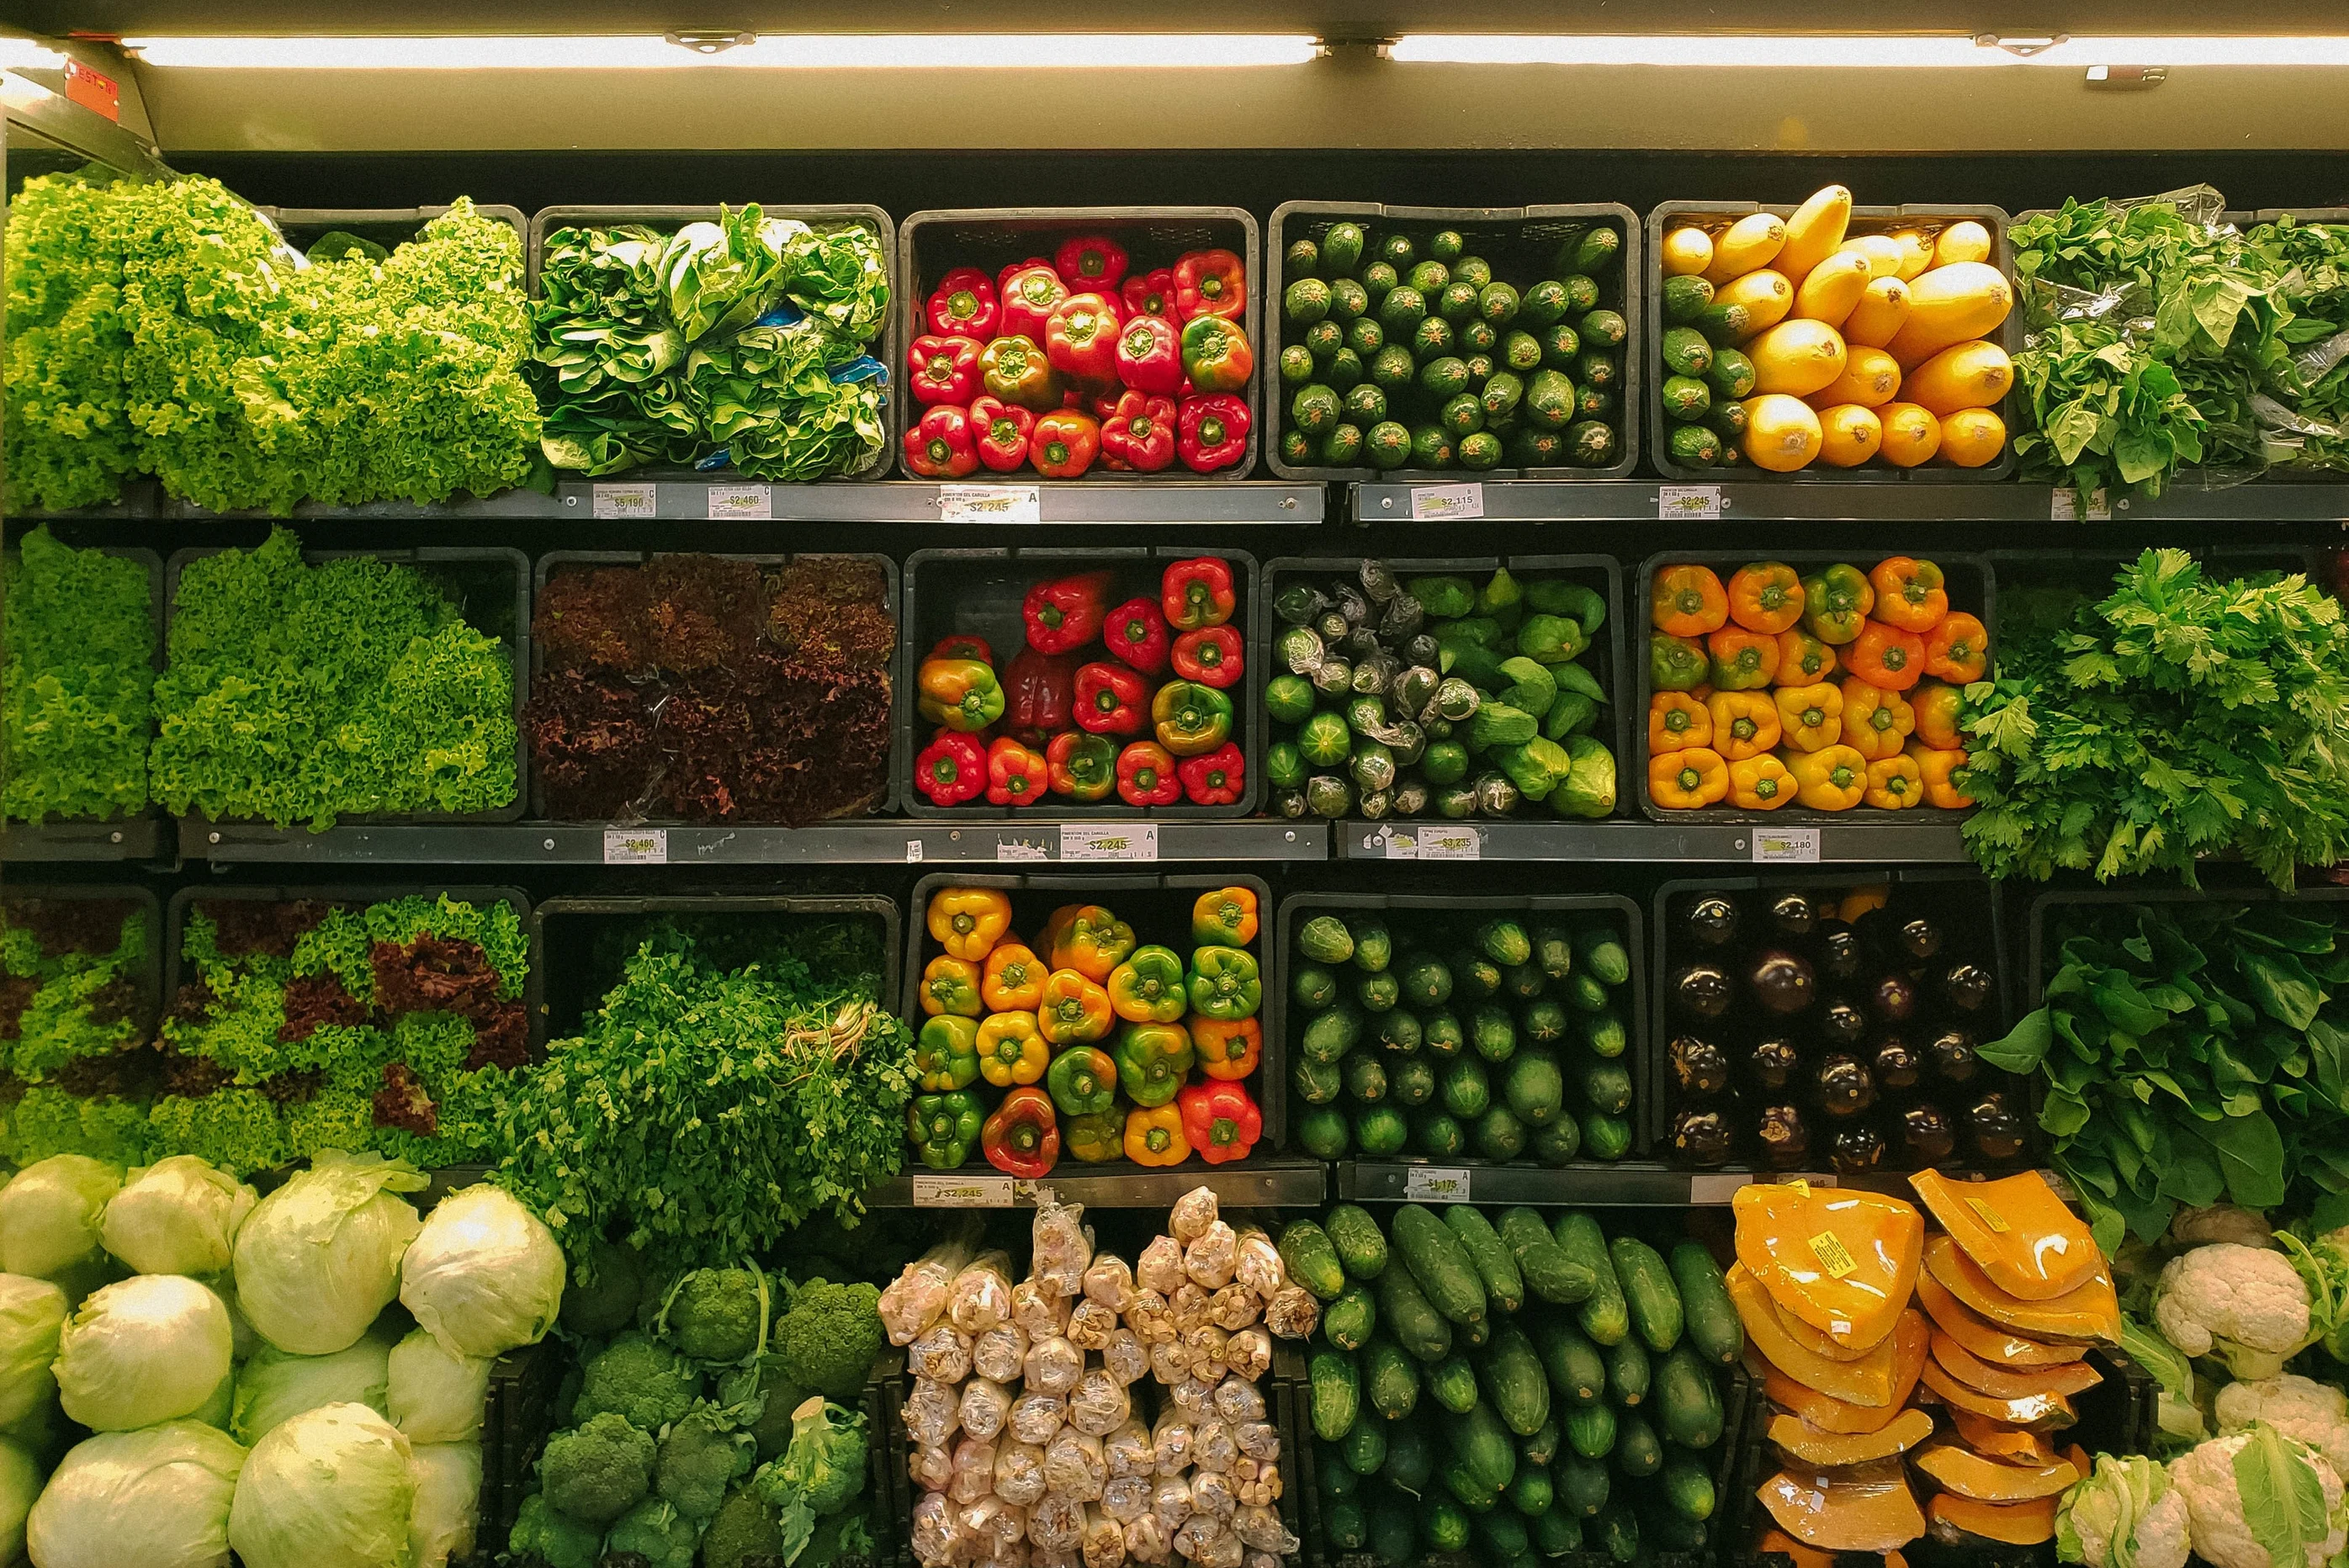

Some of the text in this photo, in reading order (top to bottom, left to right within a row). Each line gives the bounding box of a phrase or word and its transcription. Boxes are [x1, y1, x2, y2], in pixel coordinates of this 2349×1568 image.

[649, 490, 655, 499] C
[764, 486, 770, 495] C
[729, 495, 759, 506] $2,460
[1028, 492, 1037, 502] A
[1681, 496, 1710, 506] $2,245
[614, 498, 644, 508] $5,190
[660, 829, 665, 839] C
[1146, 830, 1154, 840] A
[625, 839, 655, 849] $2,460
[1089, 840, 1127, 851] $2,245
[1442, 838, 1471, 848] $3,235
[1462, 1171, 1468, 1180] A
[1002, 1182, 1010, 1190] A
[944, 1189, 983, 1198] $2,245
